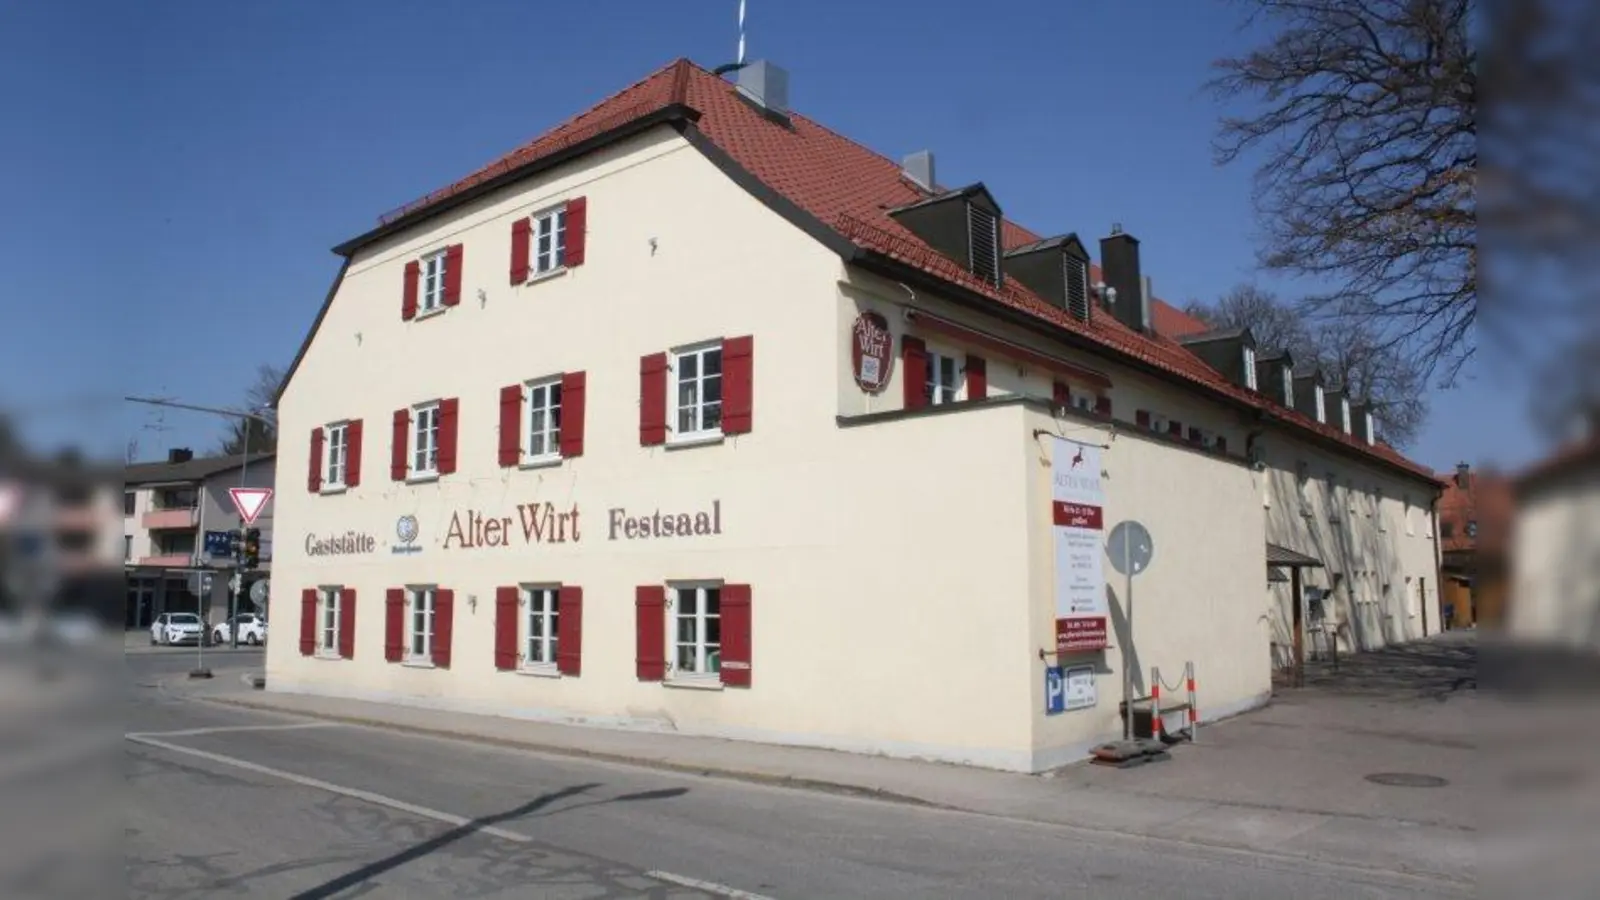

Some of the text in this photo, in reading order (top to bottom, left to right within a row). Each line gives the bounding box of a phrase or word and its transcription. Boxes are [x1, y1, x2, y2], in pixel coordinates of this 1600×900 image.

[858, 333, 884, 358] Wirt
[443, 501, 581, 549] Alter Wirt
[607, 499, 721, 541] Festsaal
[305, 531, 376, 557] Gaststätte
[1048, 672, 1062, 709] P
